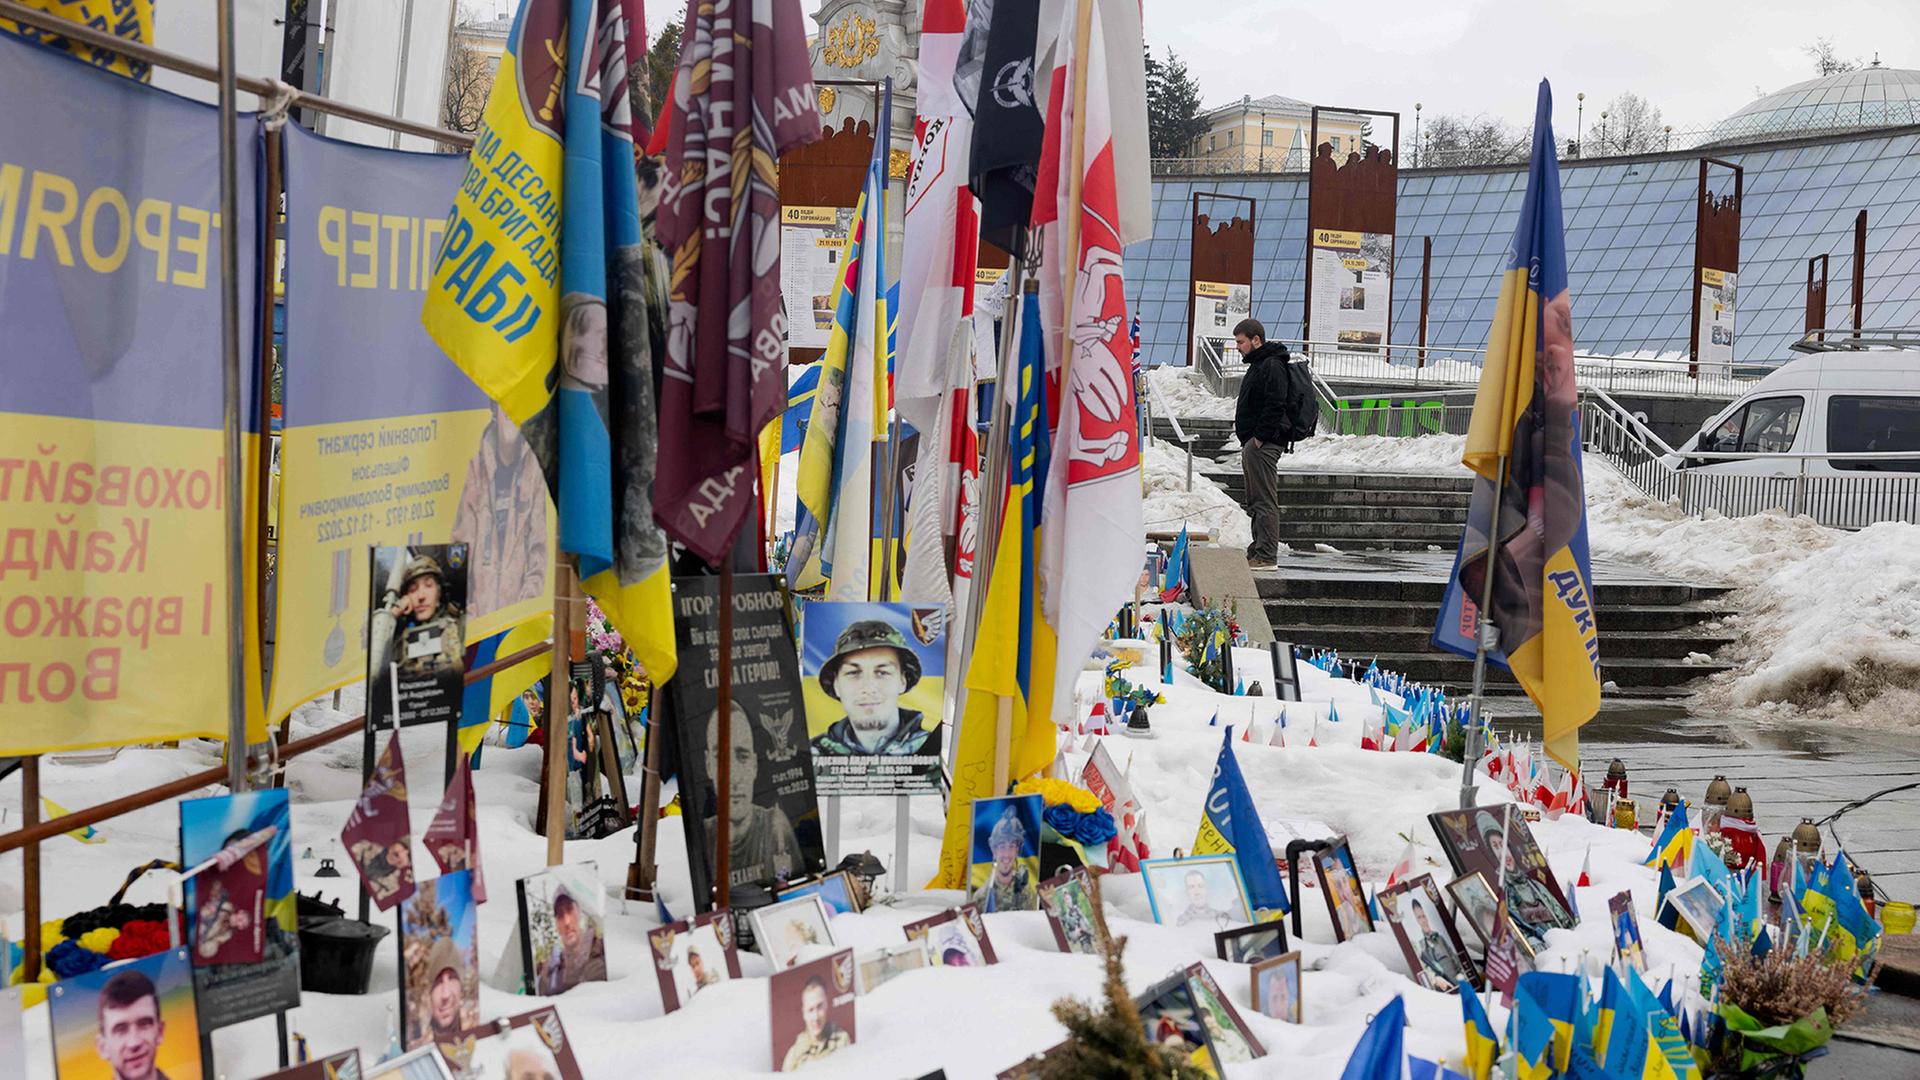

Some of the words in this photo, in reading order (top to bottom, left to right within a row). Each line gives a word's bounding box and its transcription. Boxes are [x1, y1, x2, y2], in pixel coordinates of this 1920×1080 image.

[787, 209, 799, 220] 40
[479, 188, 558, 288] БРИГАДА
[1319, 232, 1329, 243] 40
[976, 270, 985, 279] 40
[681, 595, 714, 618] ІГОР
[1547, 569, 1593, 636] ДУК
[704, 665, 741, 689] СЛА
